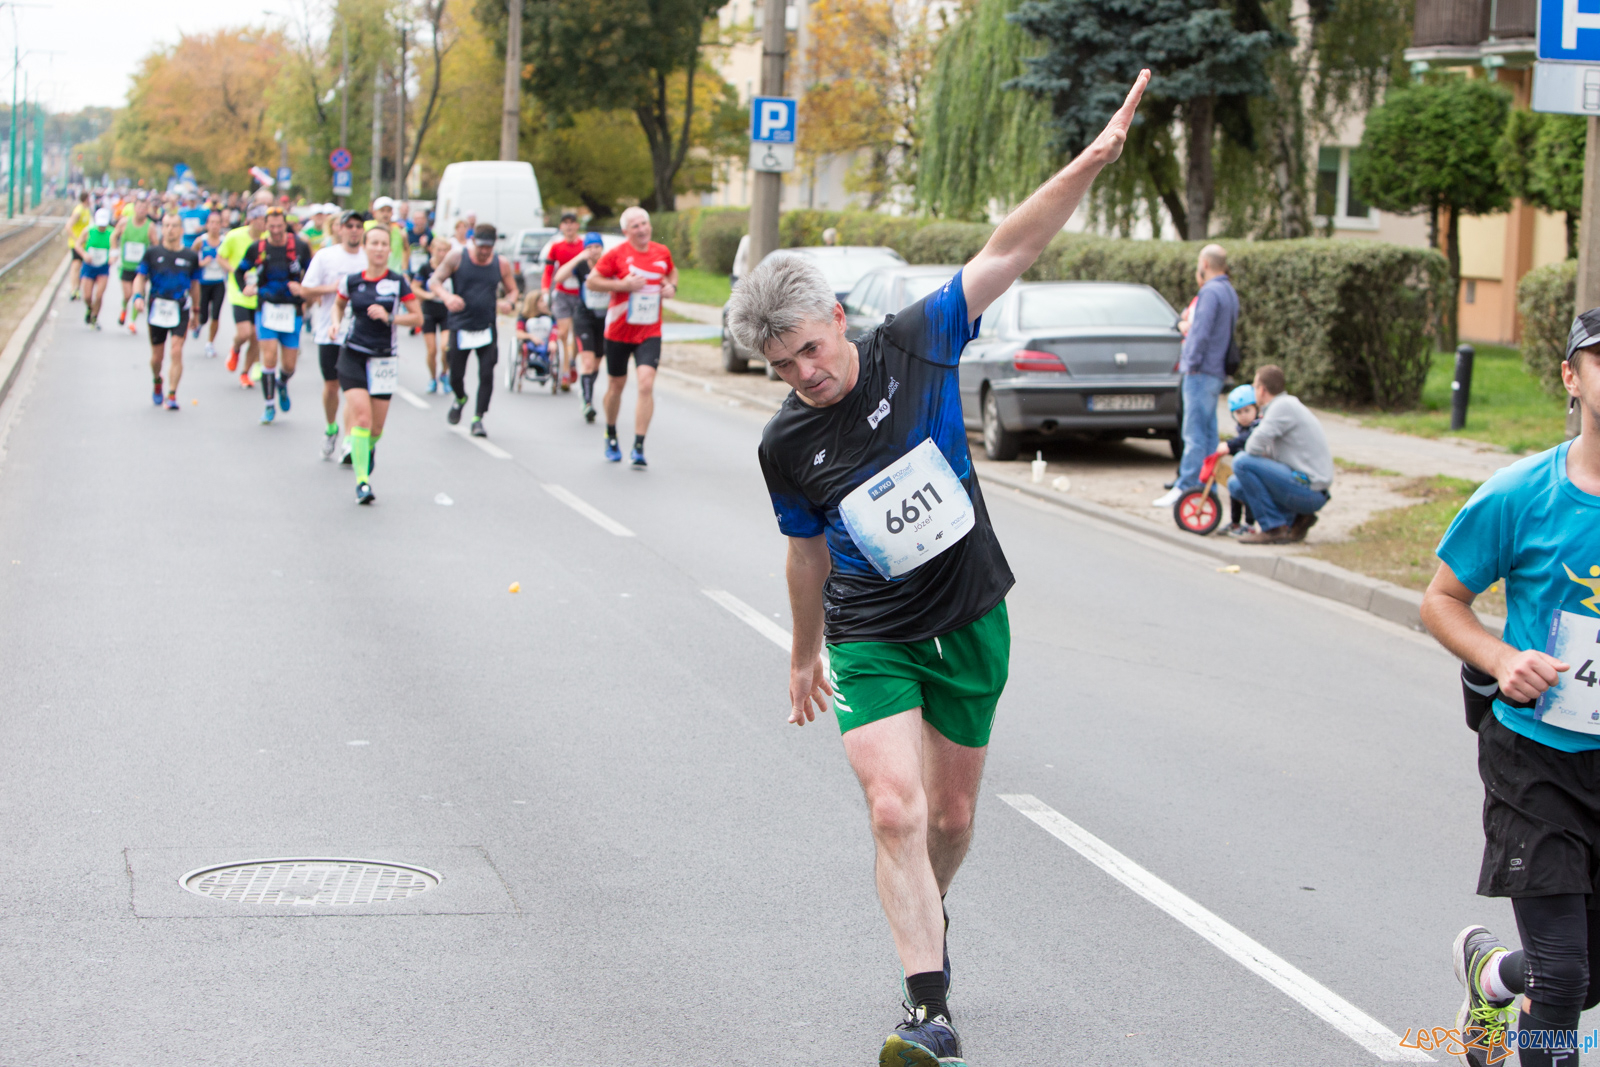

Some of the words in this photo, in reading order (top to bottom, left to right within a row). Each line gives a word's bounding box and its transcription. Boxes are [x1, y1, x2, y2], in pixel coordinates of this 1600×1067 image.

[760, 101, 788, 138] P
[813, 449, 826, 466] 4F
[879, 480, 893, 492] PKO
[885, 482, 943, 534] 6611
[1574, 659, 1600, 687] 4
